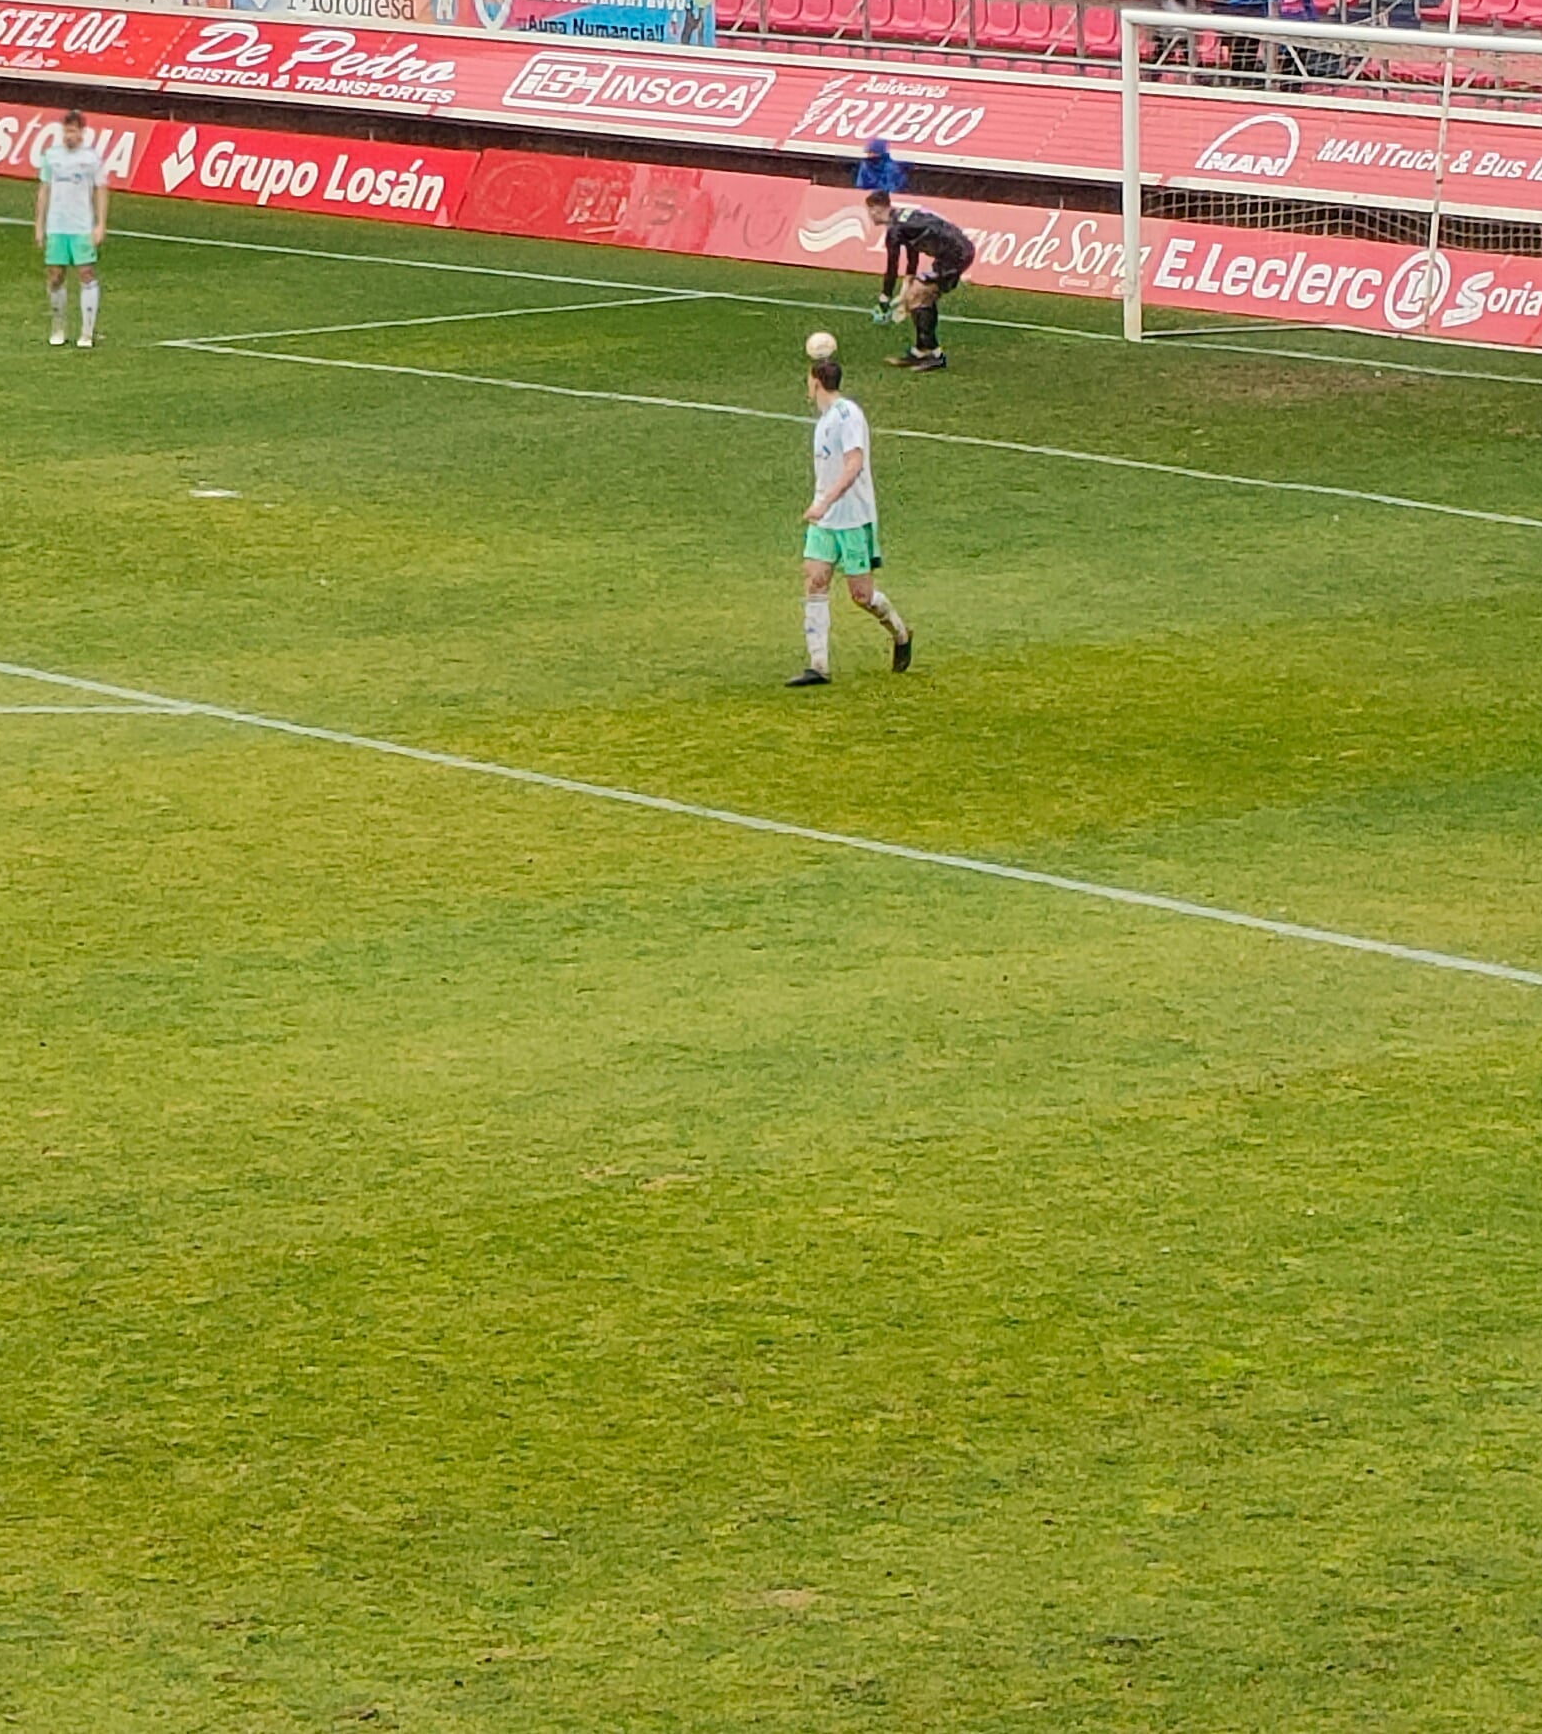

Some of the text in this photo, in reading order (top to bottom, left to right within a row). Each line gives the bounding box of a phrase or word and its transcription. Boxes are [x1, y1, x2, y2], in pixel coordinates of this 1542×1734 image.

[186, 20, 457, 85] De Pedro
[156, 63, 456, 104] LOGISTICA & TRANSPORTES
[815, 97, 985, 147] RUBIO
[199, 141, 446, 212] Grupo Losán
[1194, 151, 1291, 178] MAN
[1317, 137, 1381, 166] MAN
[1449, 149, 1472, 174] &
[1473, 152, 1526, 179] Bus
[1013, 211, 1061, 269] de
[1153, 237, 1383, 311] E.Leclerc
